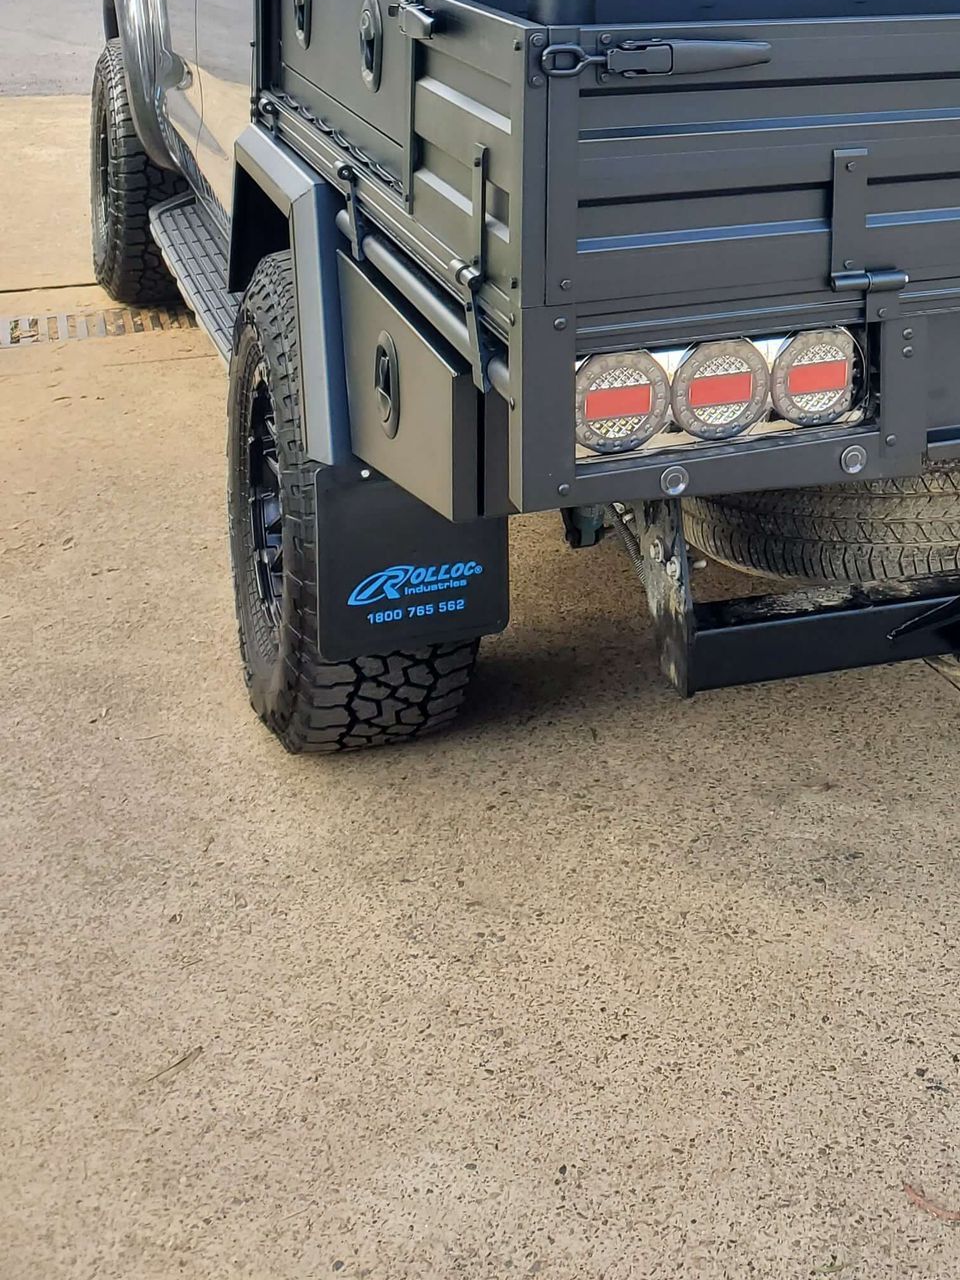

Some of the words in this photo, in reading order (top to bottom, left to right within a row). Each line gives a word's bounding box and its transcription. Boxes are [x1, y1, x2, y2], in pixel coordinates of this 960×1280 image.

[404, 579, 467, 596] Industries
[367, 609, 402, 624] 1800
[407, 604, 434, 618] 765
[438, 599, 465, 612] 562
